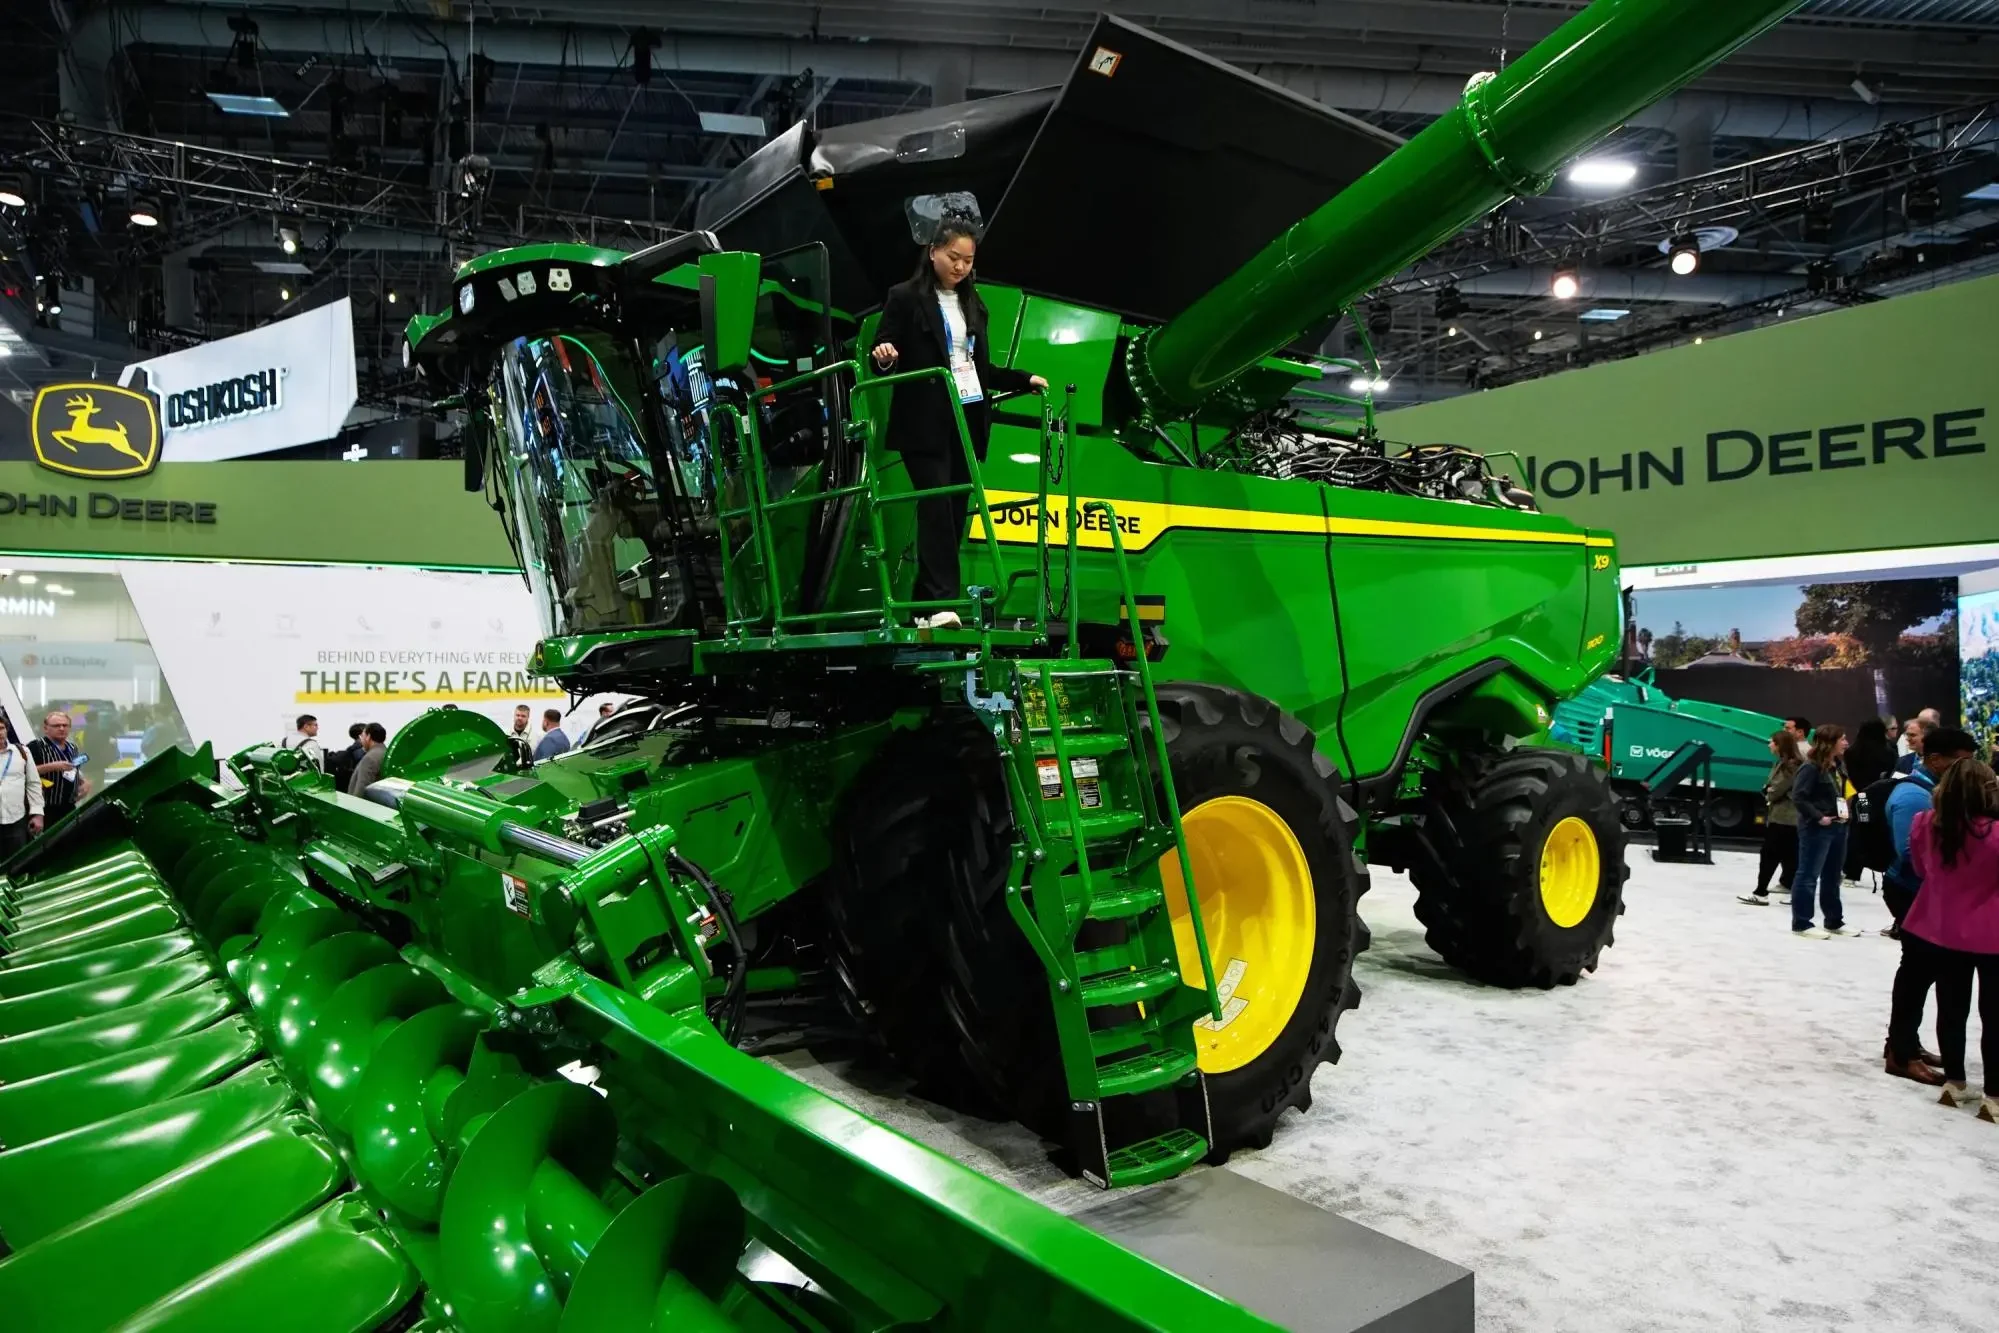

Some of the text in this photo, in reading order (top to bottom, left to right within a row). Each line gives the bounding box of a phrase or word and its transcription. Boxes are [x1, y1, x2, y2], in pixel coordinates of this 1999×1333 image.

[168, 368, 277, 428] OSHKOSH
[1706, 408, 1986, 482] DEERE
[88, 492, 217, 524] DEERE
[994, 507, 1059, 529] JOHN
[1593, 554, 1609, 570] X9
[41, 655, 107, 669] LG Display
[318, 651, 529, 664] BEHIND EVERYTHING WE RELY
[300, 671, 564, 694] THERE'S A FARME
